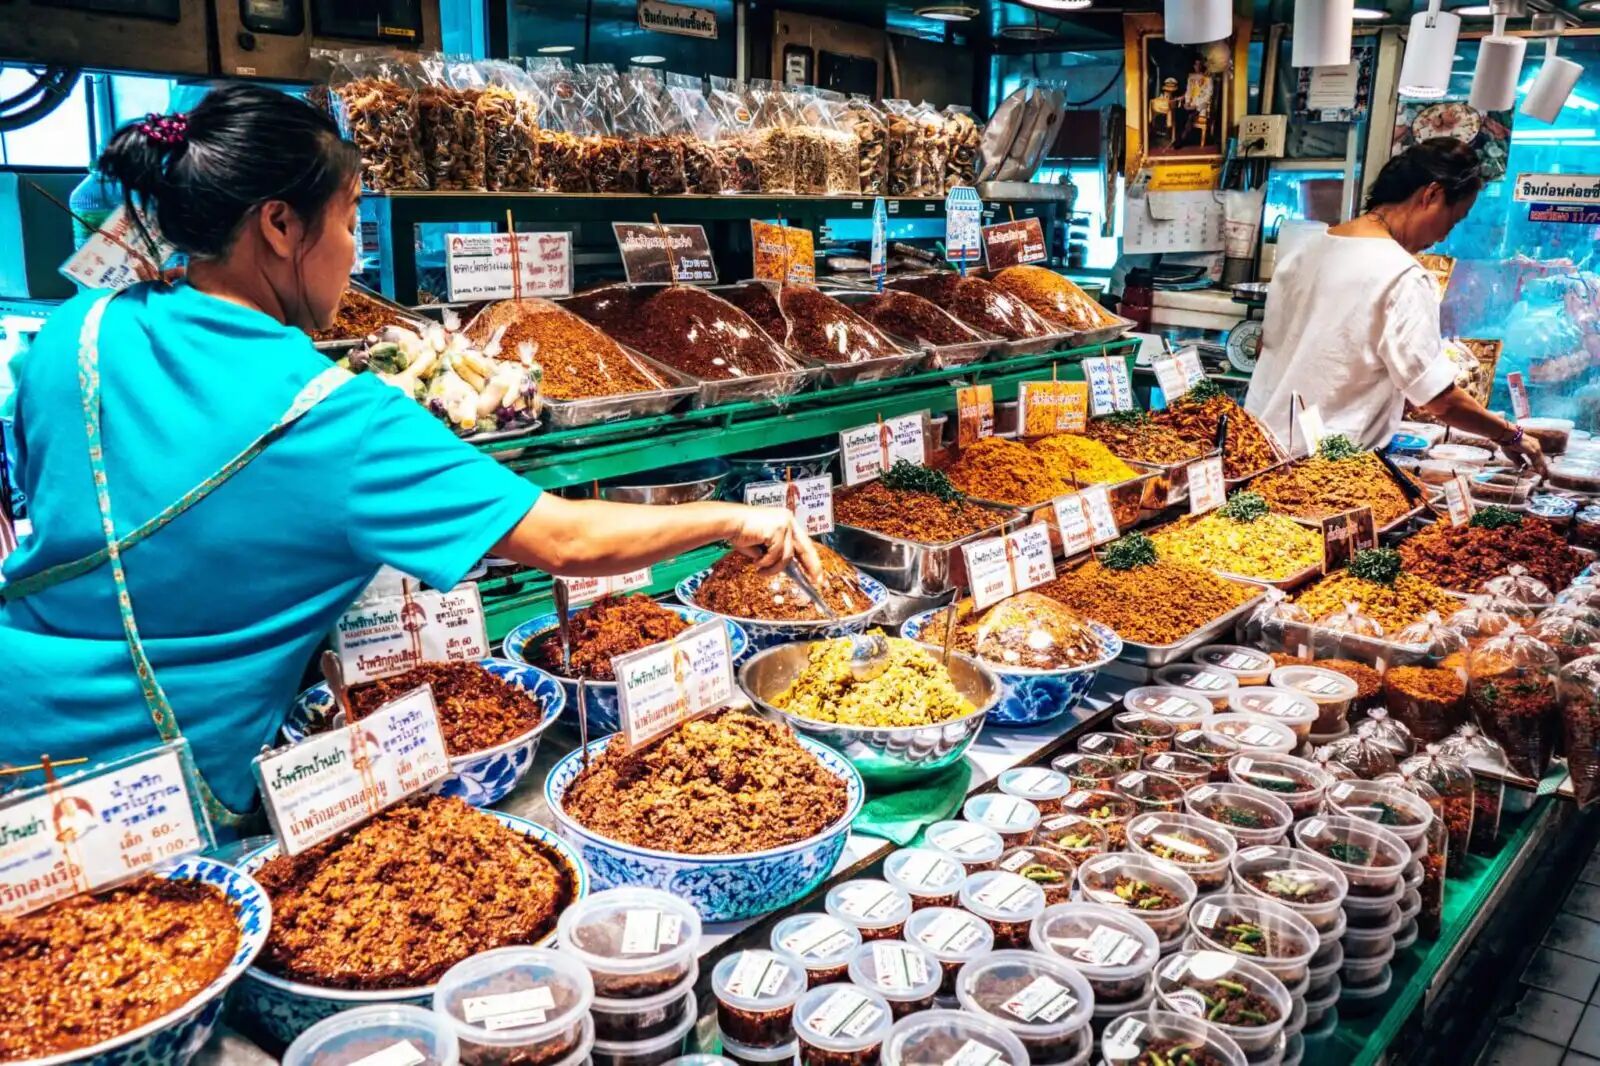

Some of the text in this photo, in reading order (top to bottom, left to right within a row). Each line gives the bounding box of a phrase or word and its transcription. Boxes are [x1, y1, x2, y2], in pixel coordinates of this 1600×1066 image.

[338, 611, 399, 632] น้ำพริกบ้านย่า
[461, 636, 472, 646] 60
[466, 646, 481, 657] 100
[271, 747, 346, 792] น้ำพริกบ้านย่า
[110, 774, 162, 798] น้ำพริก
[101, 786, 181, 823] สูตรโบราณ
[121, 804, 167, 827] รสเด็ด
[119, 831, 143, 851] เล็ก
[120, 846, 153, 869] ใหญ่
